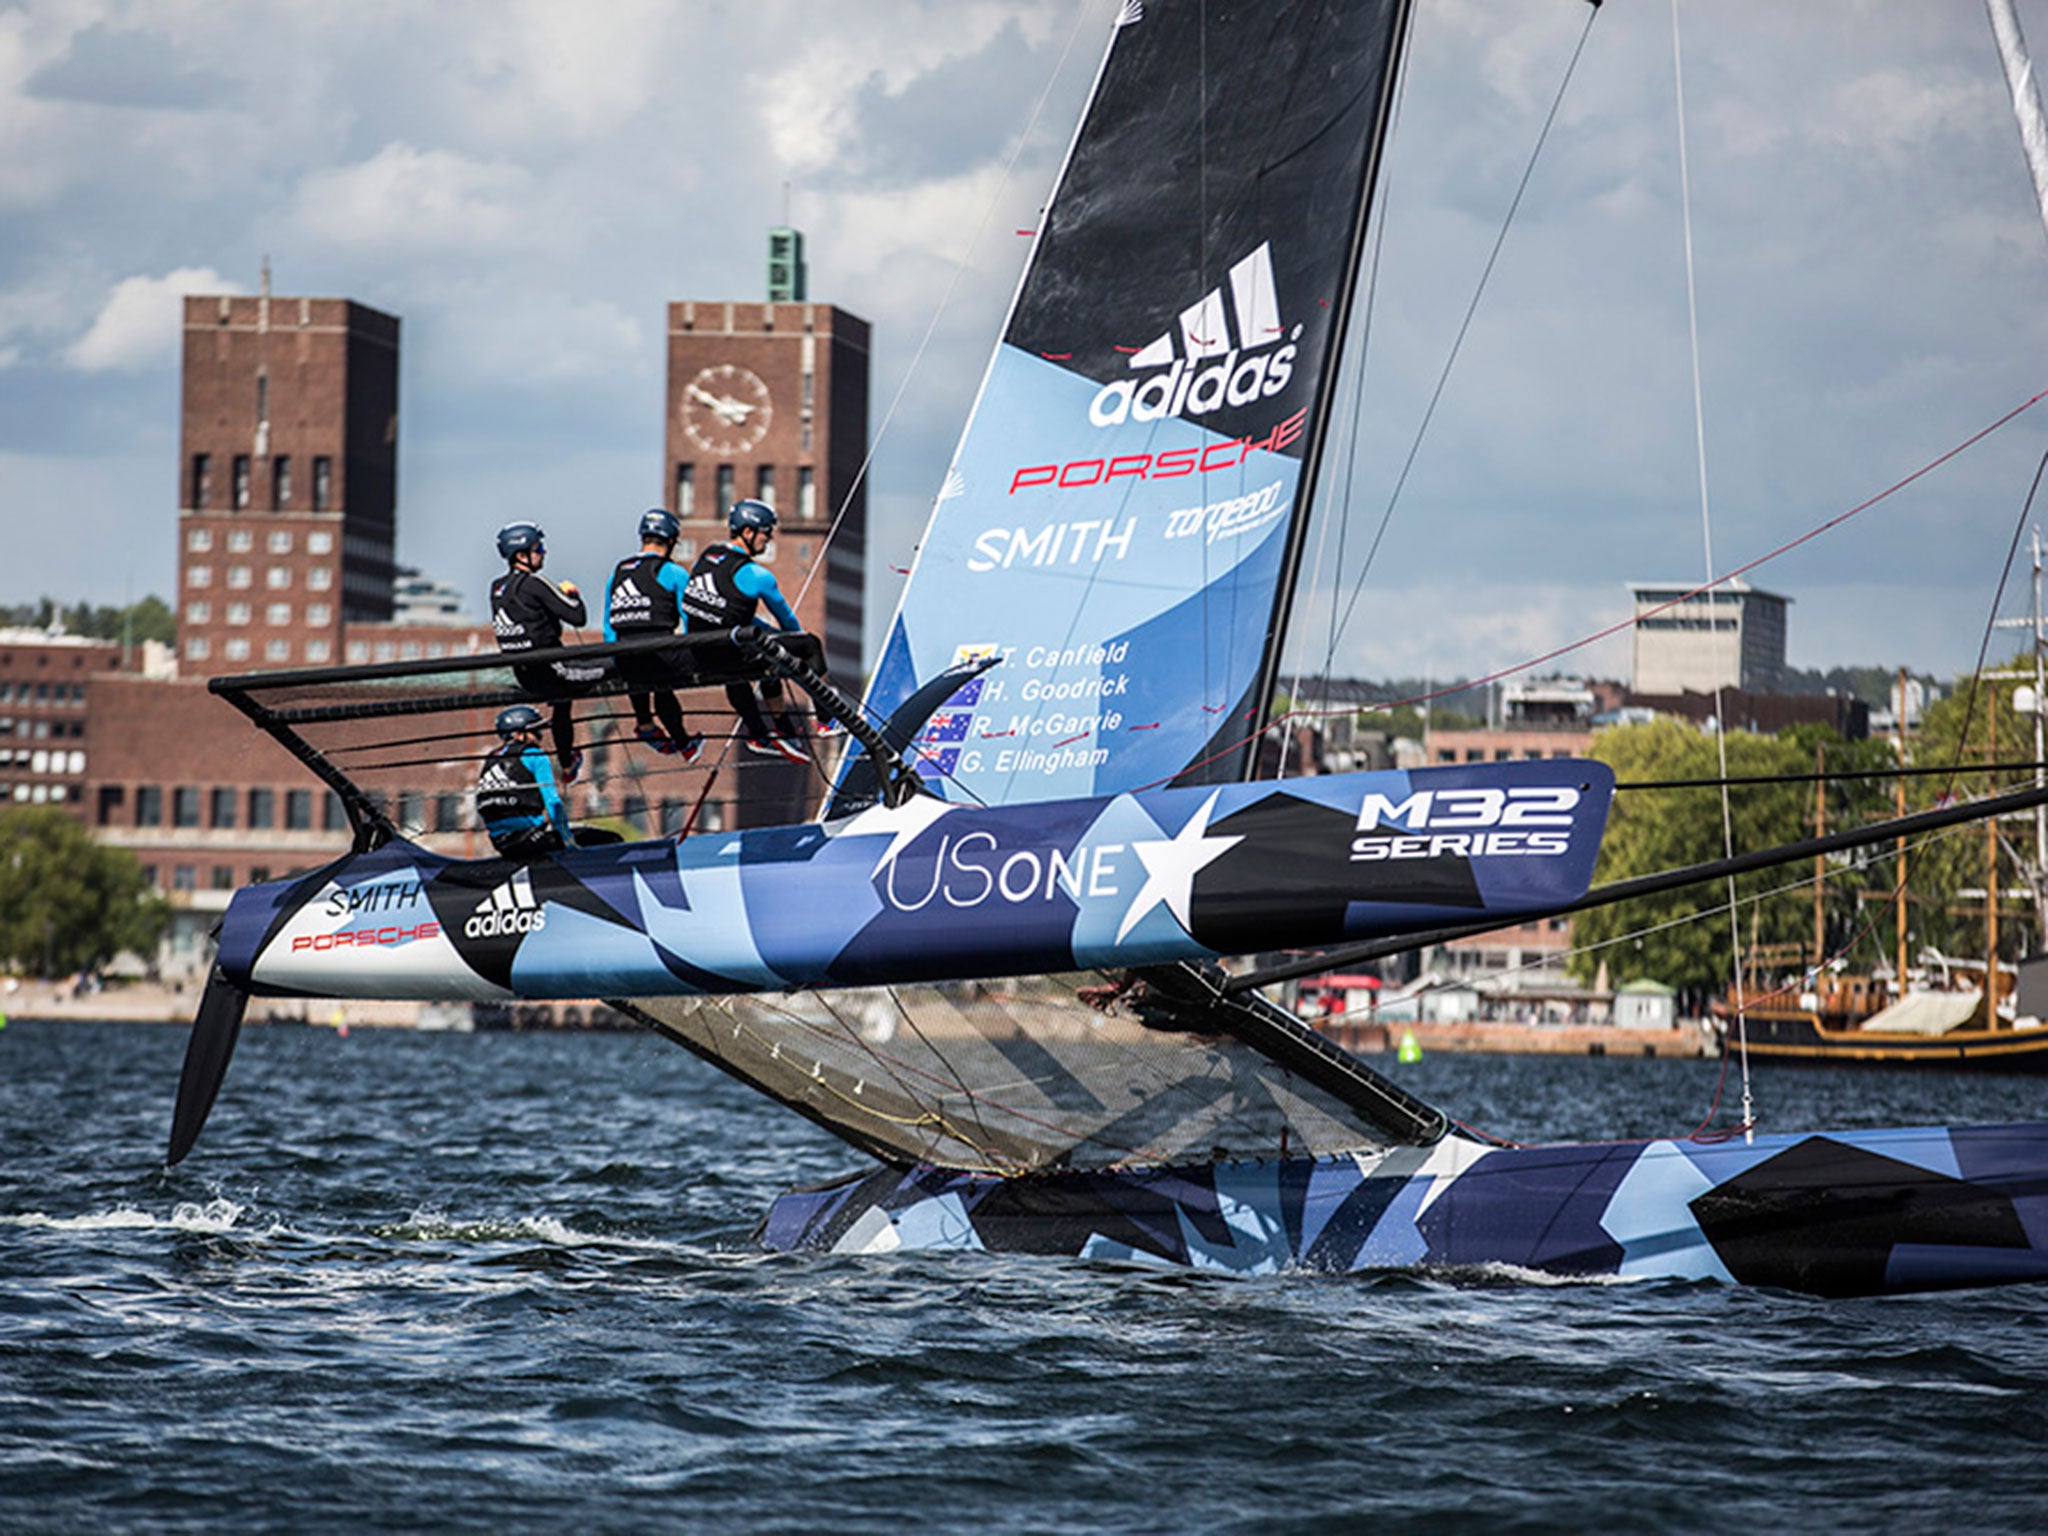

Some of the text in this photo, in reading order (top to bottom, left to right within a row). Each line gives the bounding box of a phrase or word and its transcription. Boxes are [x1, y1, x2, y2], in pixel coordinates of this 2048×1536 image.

[1089, 343, 1298, 427] adidas
[1009, 407, 1308, 495] PORSCHE
[967, 515, 1138, 571] SMITH
[1000, 640, 1131, 669] T. Canfield
[984, 673, 1131, 702] H. Goodrick
[1008, 708, 1123, 738] McGarvie
[961, 747, 1110, 775] G. Ellingham
[1355, 786, 1580, 832] M32
[1349, 831, 1572, 861] SERIES
[325, 881, 427, 917] SMITH
[291, 921, 441, 952] PORSCHE
[464, 907, 547, 938] adidas
